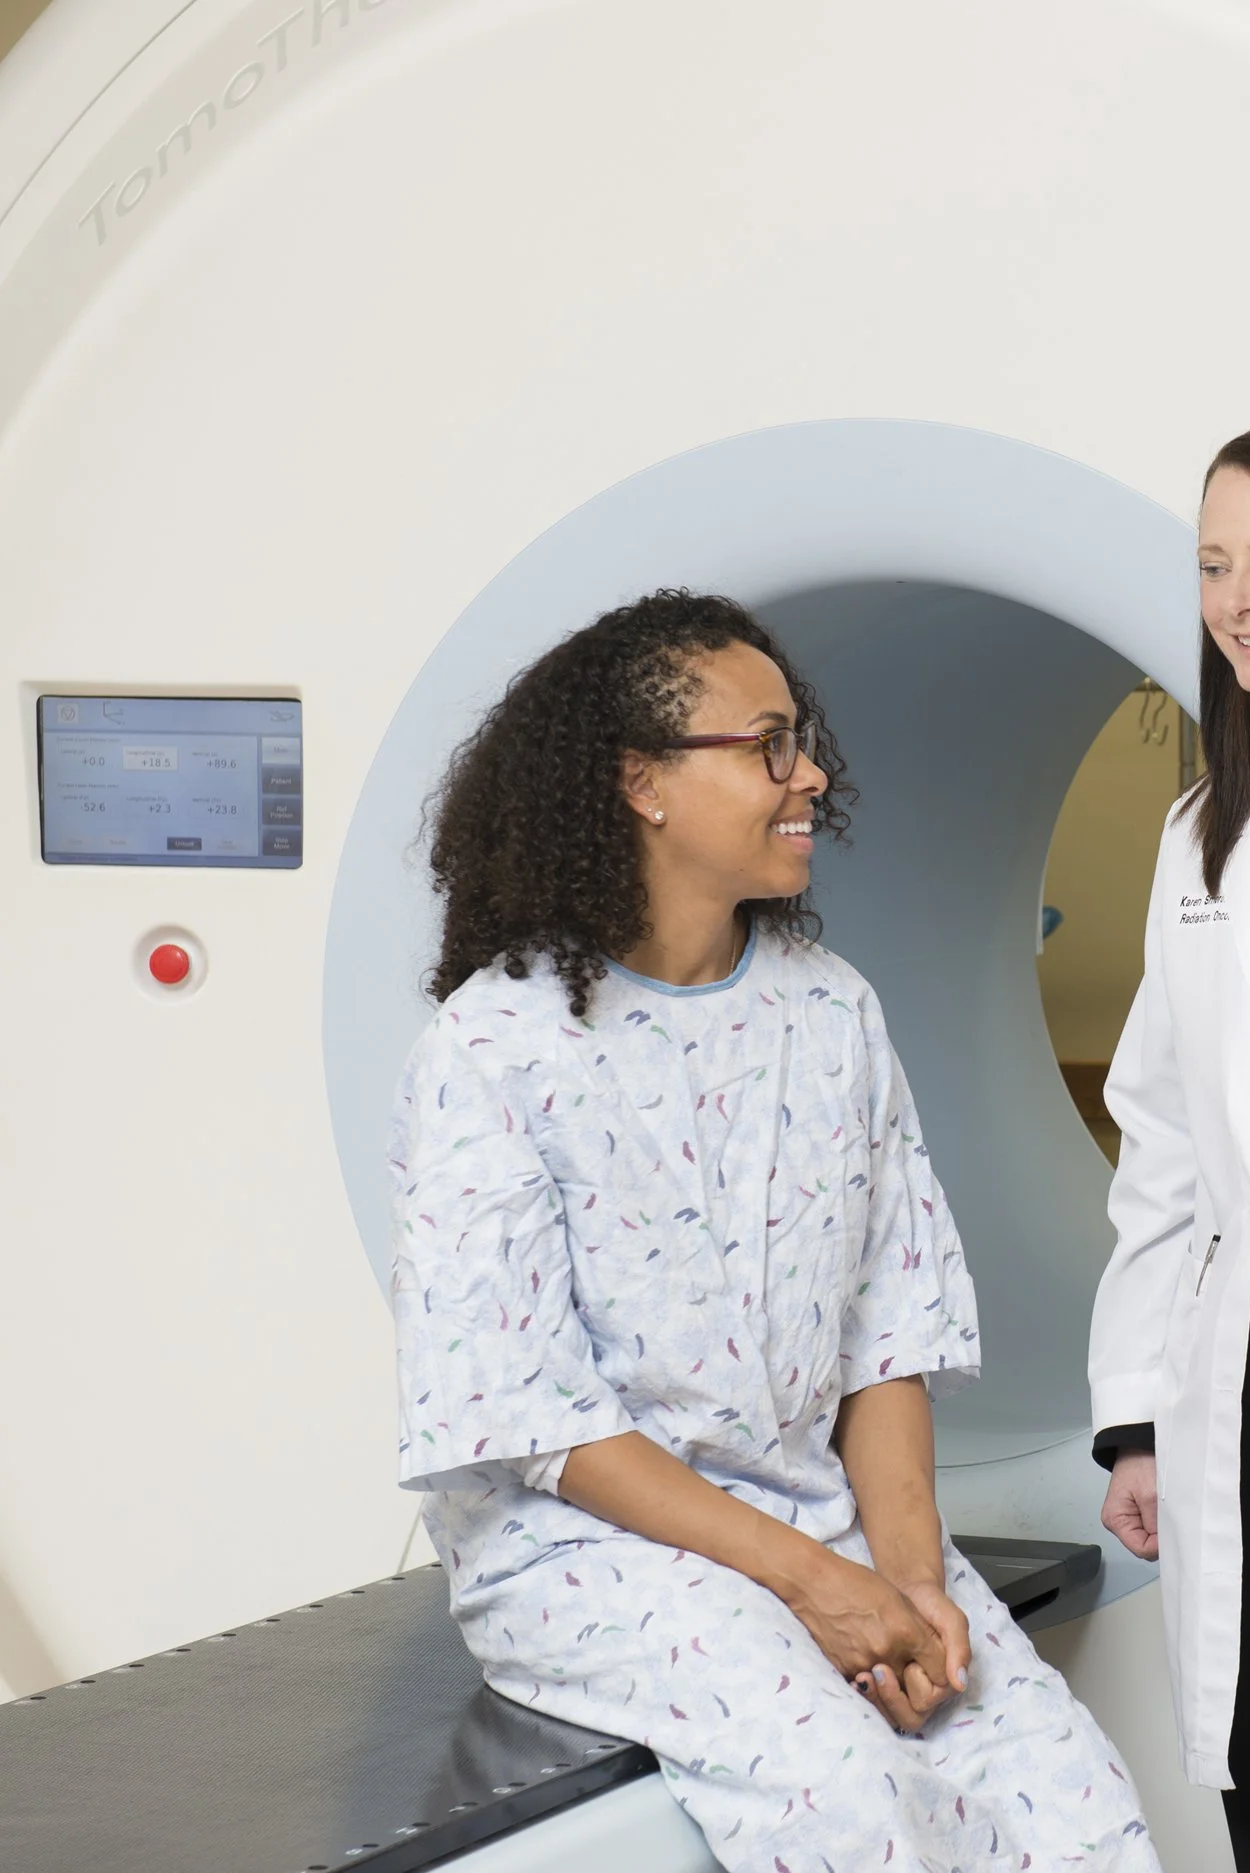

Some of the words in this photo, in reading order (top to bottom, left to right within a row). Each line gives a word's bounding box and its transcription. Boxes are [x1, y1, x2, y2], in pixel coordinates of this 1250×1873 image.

[76, 0, 391, 247] TomoTh
[141, 757, 171, 768] +18.5
[206, 759, 237, 769] +89.6
[207, 805, 237, 815] +23.8
[1180, 895, 1203, 907] Karen
[1180, 912, 1211, 924] Radiation
